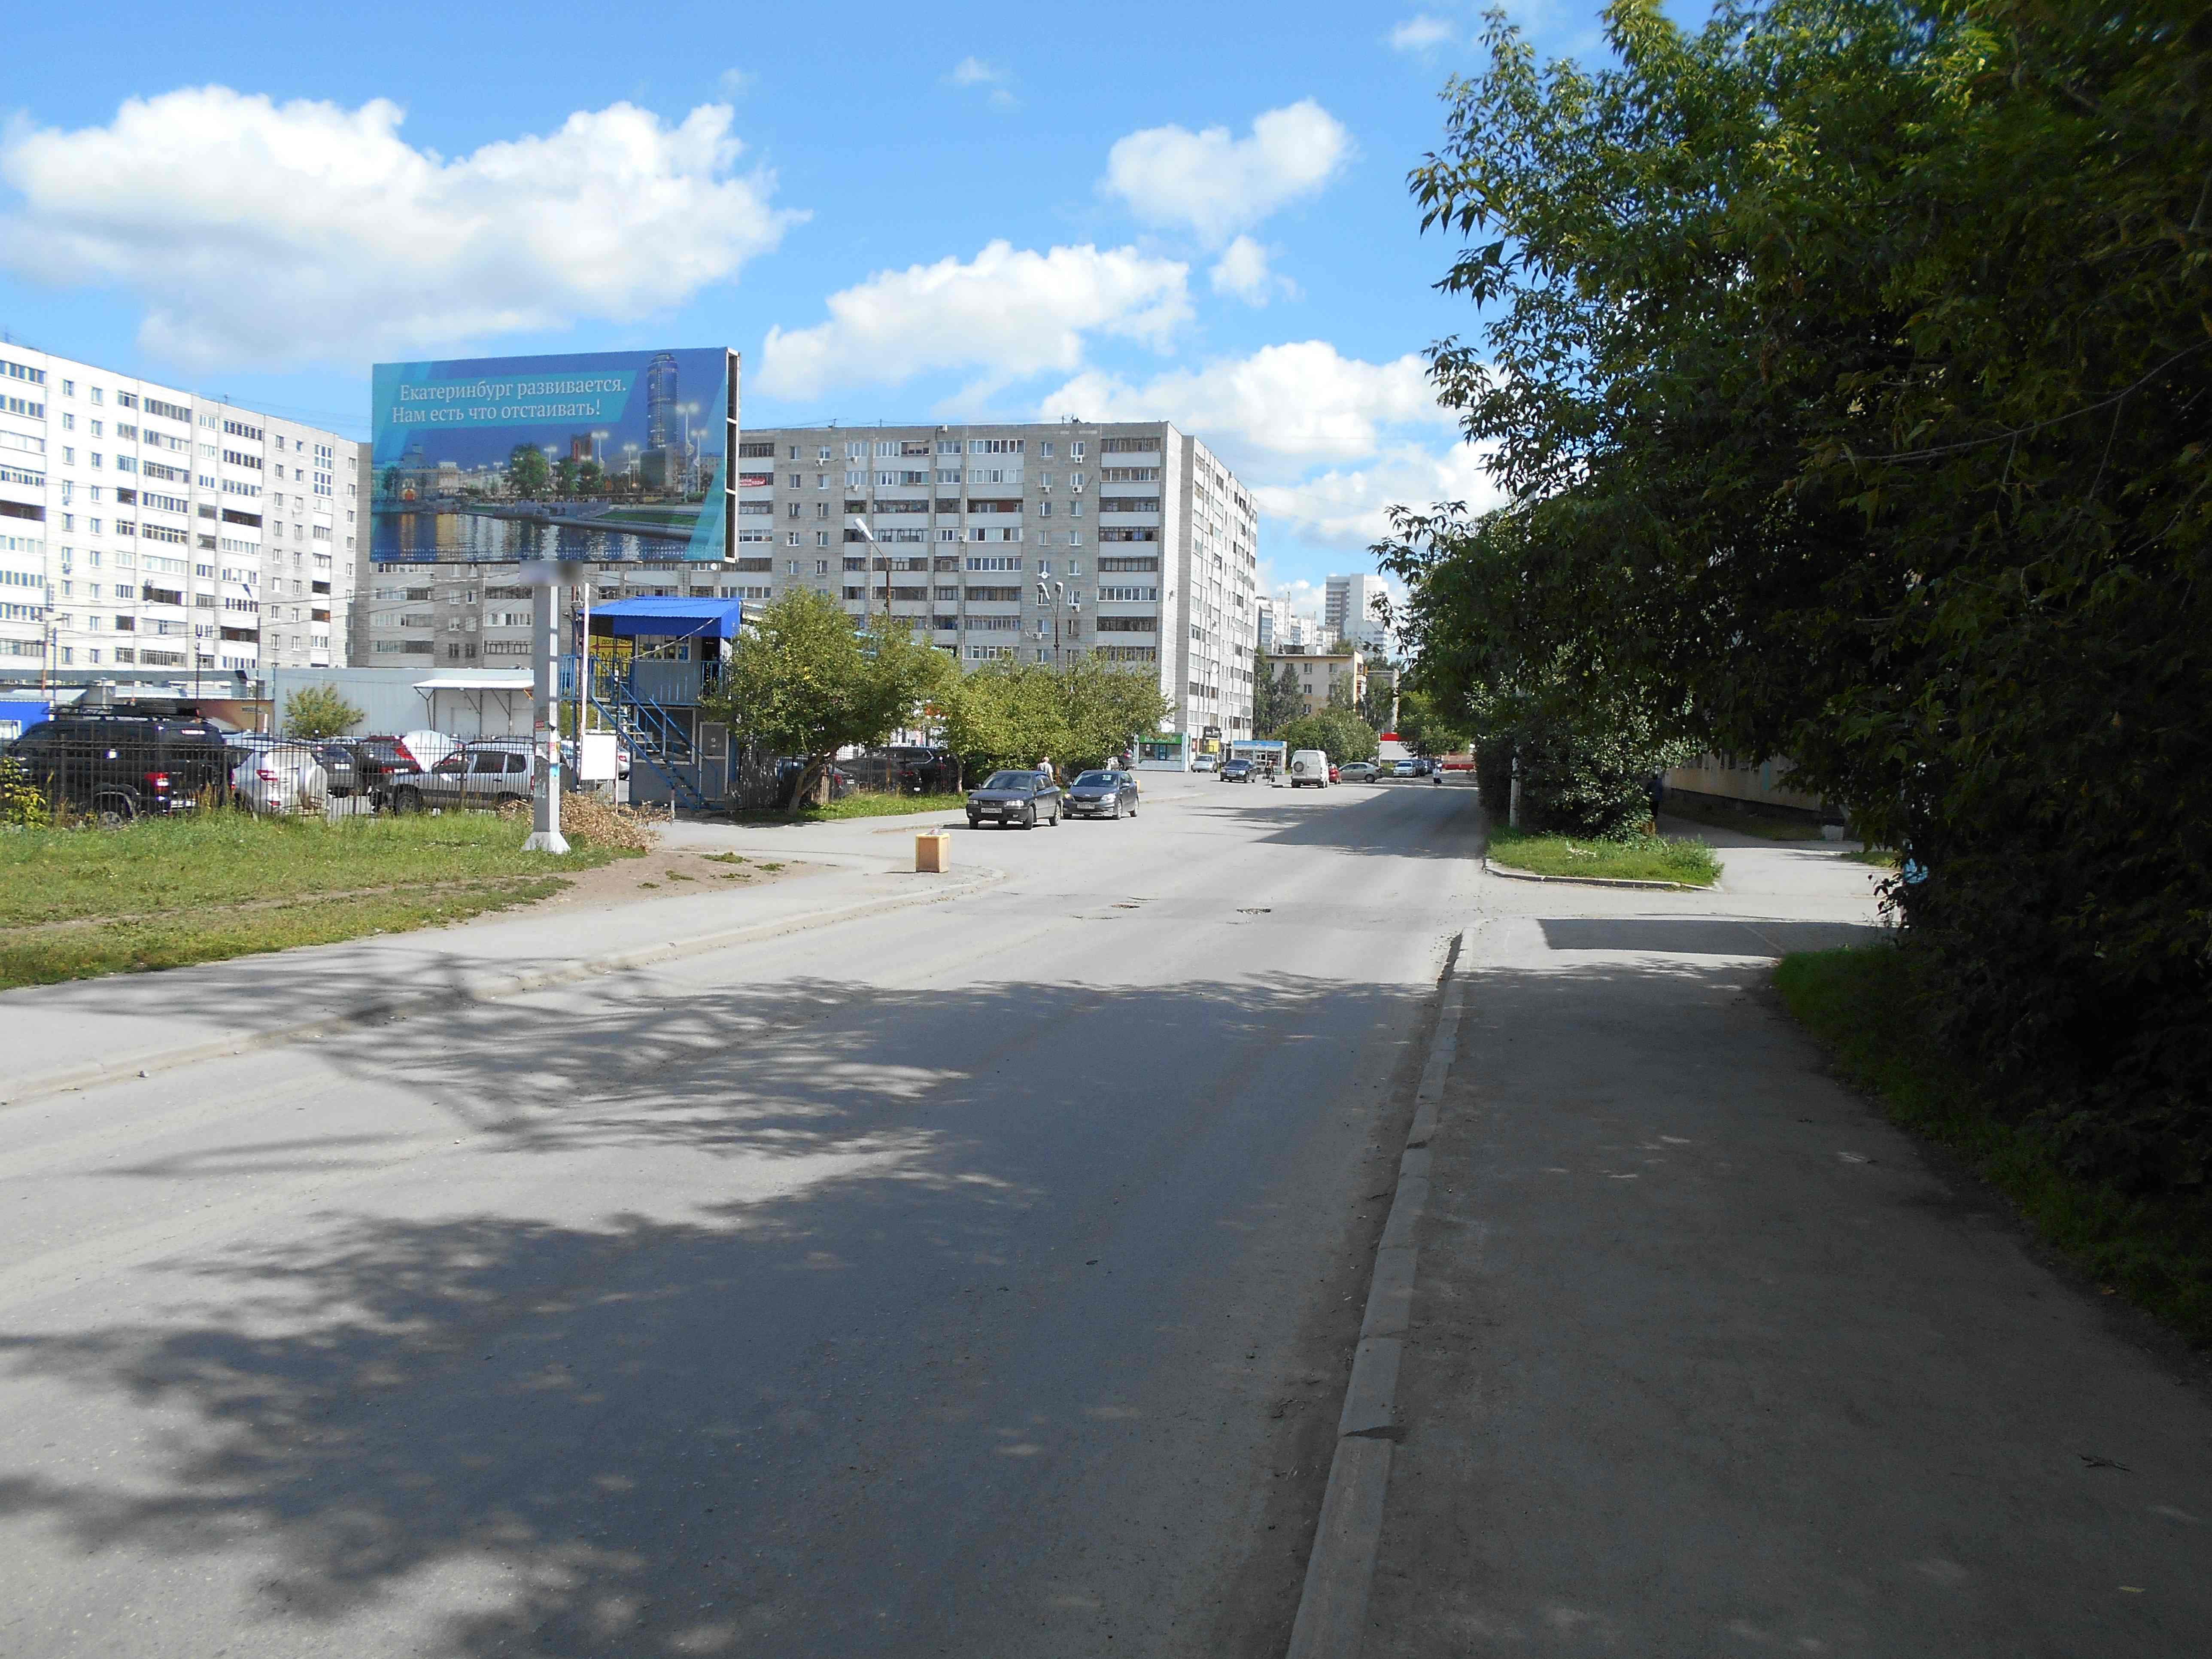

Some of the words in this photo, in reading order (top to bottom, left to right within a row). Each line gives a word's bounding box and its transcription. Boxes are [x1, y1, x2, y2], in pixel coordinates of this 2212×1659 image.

[400, 381, 513, 403] Екатеринбург
[517, 379, 627, 400] развивается.
[392, 407, 426, 423] Нам
[430, 408, 465, 421] есть
[468, 407, 497, 419] что
[501, 399, 600, 419] отстаивать!
